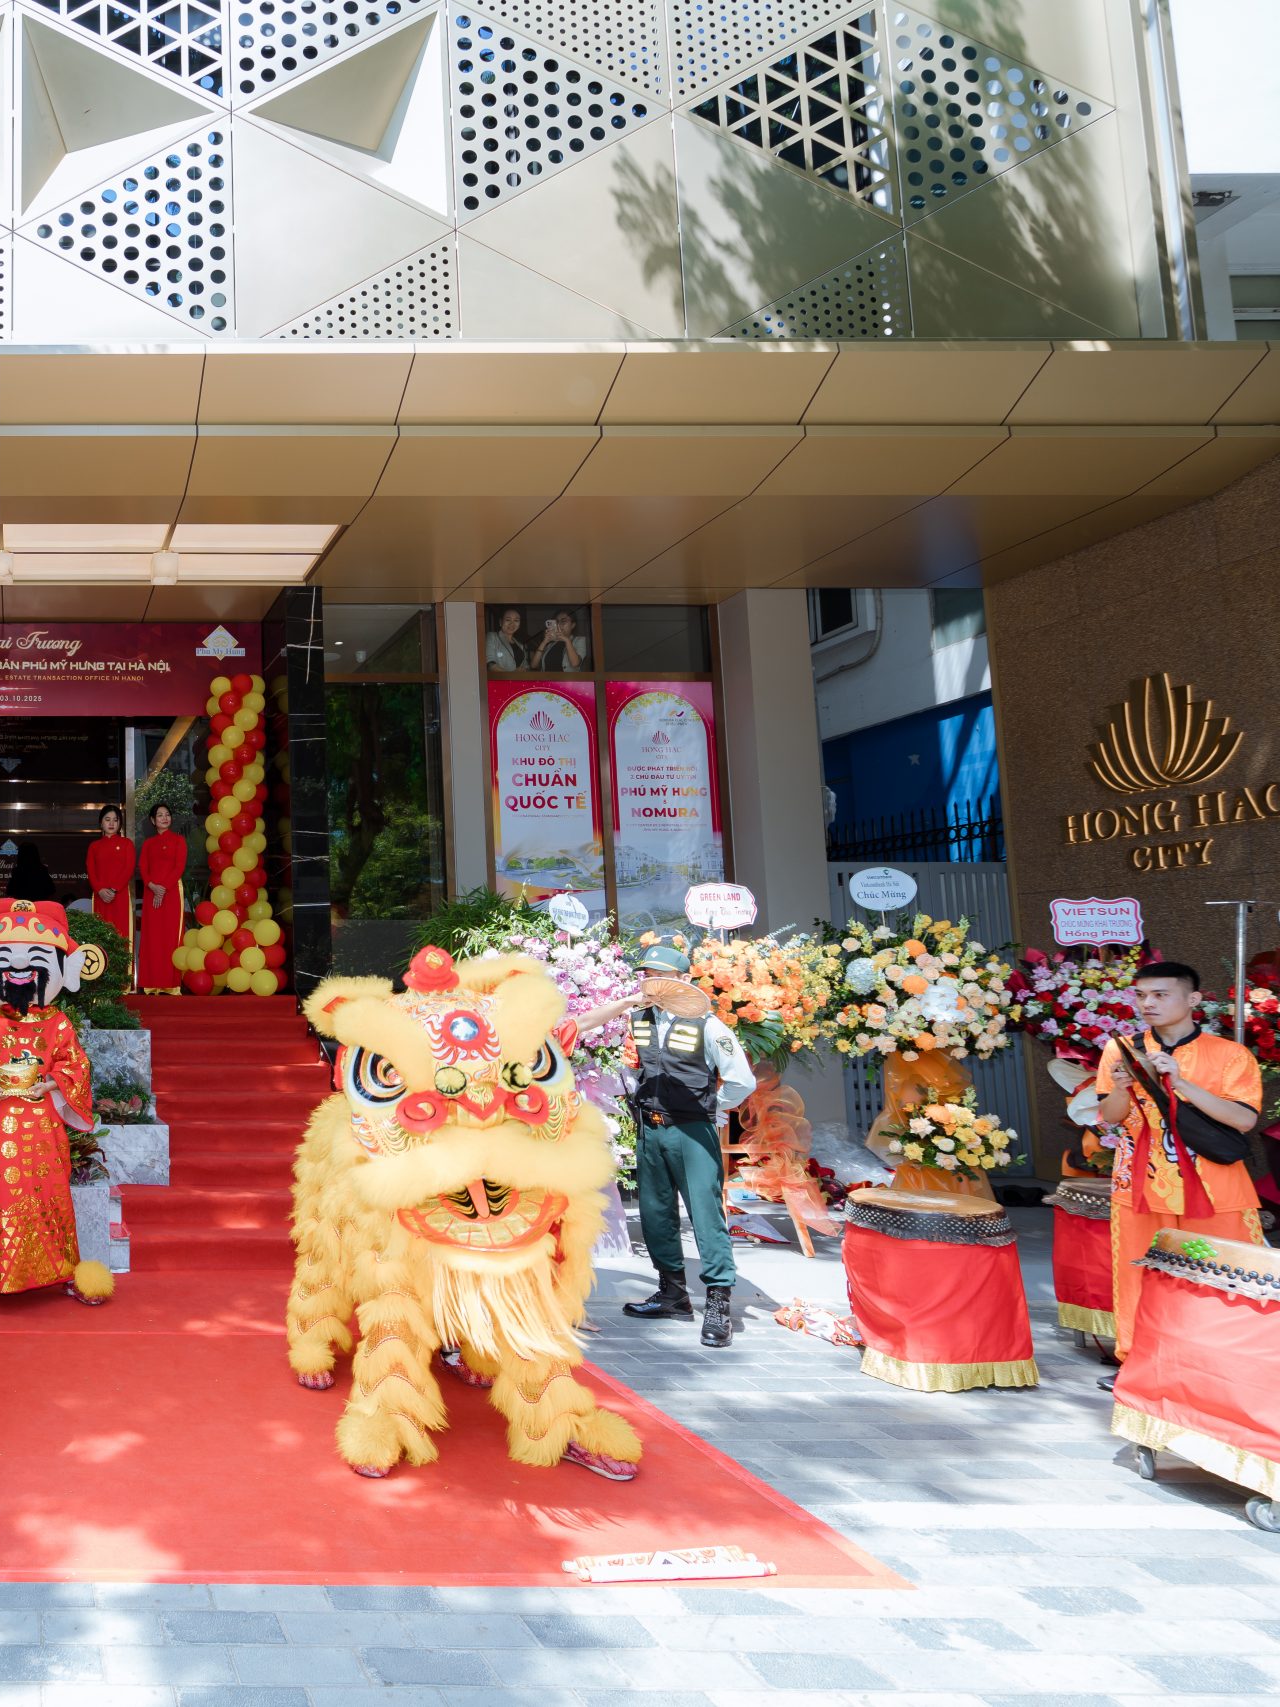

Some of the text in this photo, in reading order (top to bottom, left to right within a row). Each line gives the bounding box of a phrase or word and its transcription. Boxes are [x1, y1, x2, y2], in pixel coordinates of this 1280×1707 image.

[22, 659, 47, 670] PHÚ
[50, 659, 67, 670] MỸ
[70, 661, 105, 671] HƯNG
[107, 661, 126, 674] TẠI
[128, 660, 146, 671] HÀ
[515, 733, 570, 742] HONG HAC
[512, 755, 576, 769] KHU ĐÔ THỊ
[511, 768, 577, 787] CHUẨN
[621, 784, 707, 797] PHÚ MỸ HƯNG
[504, 790, 587, 812] QUỐC TẾ
[631, 807, 699, 818] NOMURA
[1064, 800, 1181, 845] HONG
[1132, 838, 1215, 872] CITY
[700, 892, 741, 901] GREEN LAND
[857, 889, 907, 900] Chúc Mừng
